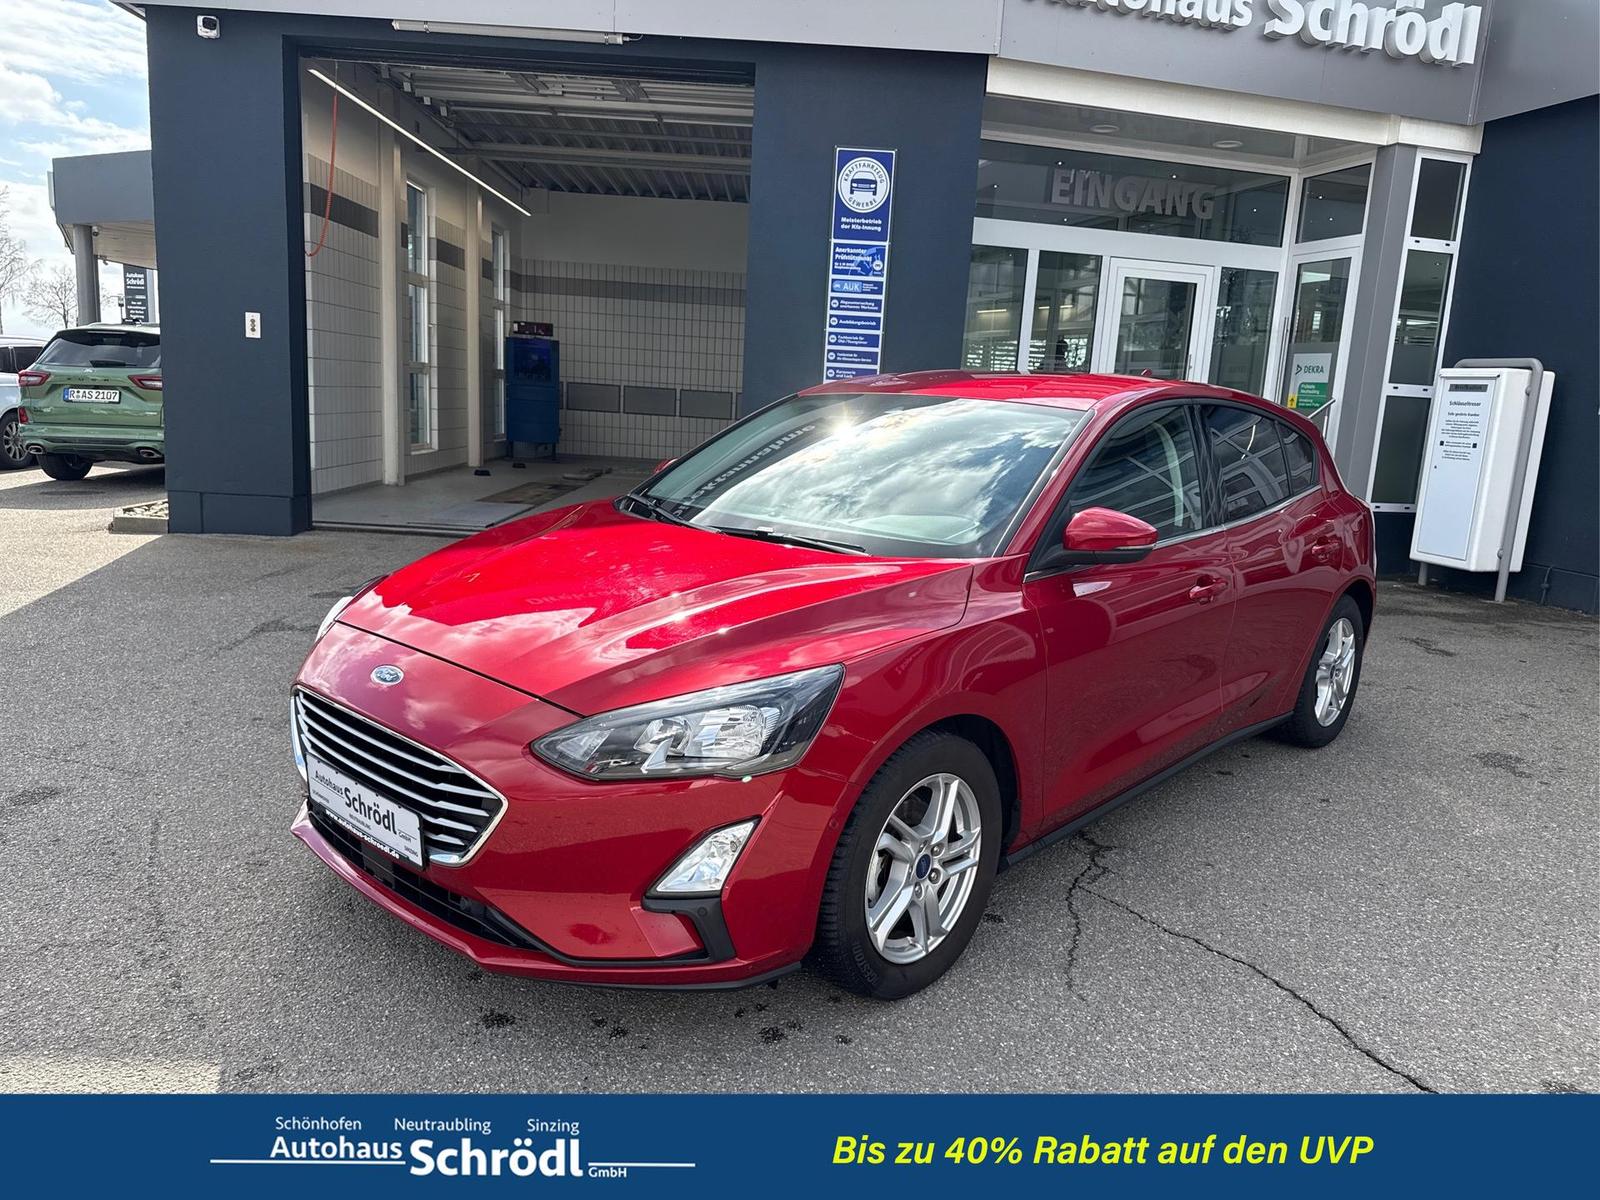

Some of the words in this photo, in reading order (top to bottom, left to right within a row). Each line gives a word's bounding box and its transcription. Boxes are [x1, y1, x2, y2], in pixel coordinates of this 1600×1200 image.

[1264, 0, 1482, 67] Schrödl
[844, 162, 885, 184] KRAFTFAHRZEUG
[848, 196, 877, 208] GEWERBE
[1051, 168, 1217, 220] EINGANG
[841, 217, 882, 225] Meisterbetrieb
[843, 282, 860, 291] AUK
[1303, 365, 1325, 374] DEKRA
[70, 390, 76, 399] R
[81, 390, 94, 399] AS
[95, 391, 118, 400] 2107
[315, 770, 343, 795] Autohaus
[344, 787, 397, 835] Schrödl
[325, 809, 400, 859] www.autohaus-schroedl.de
